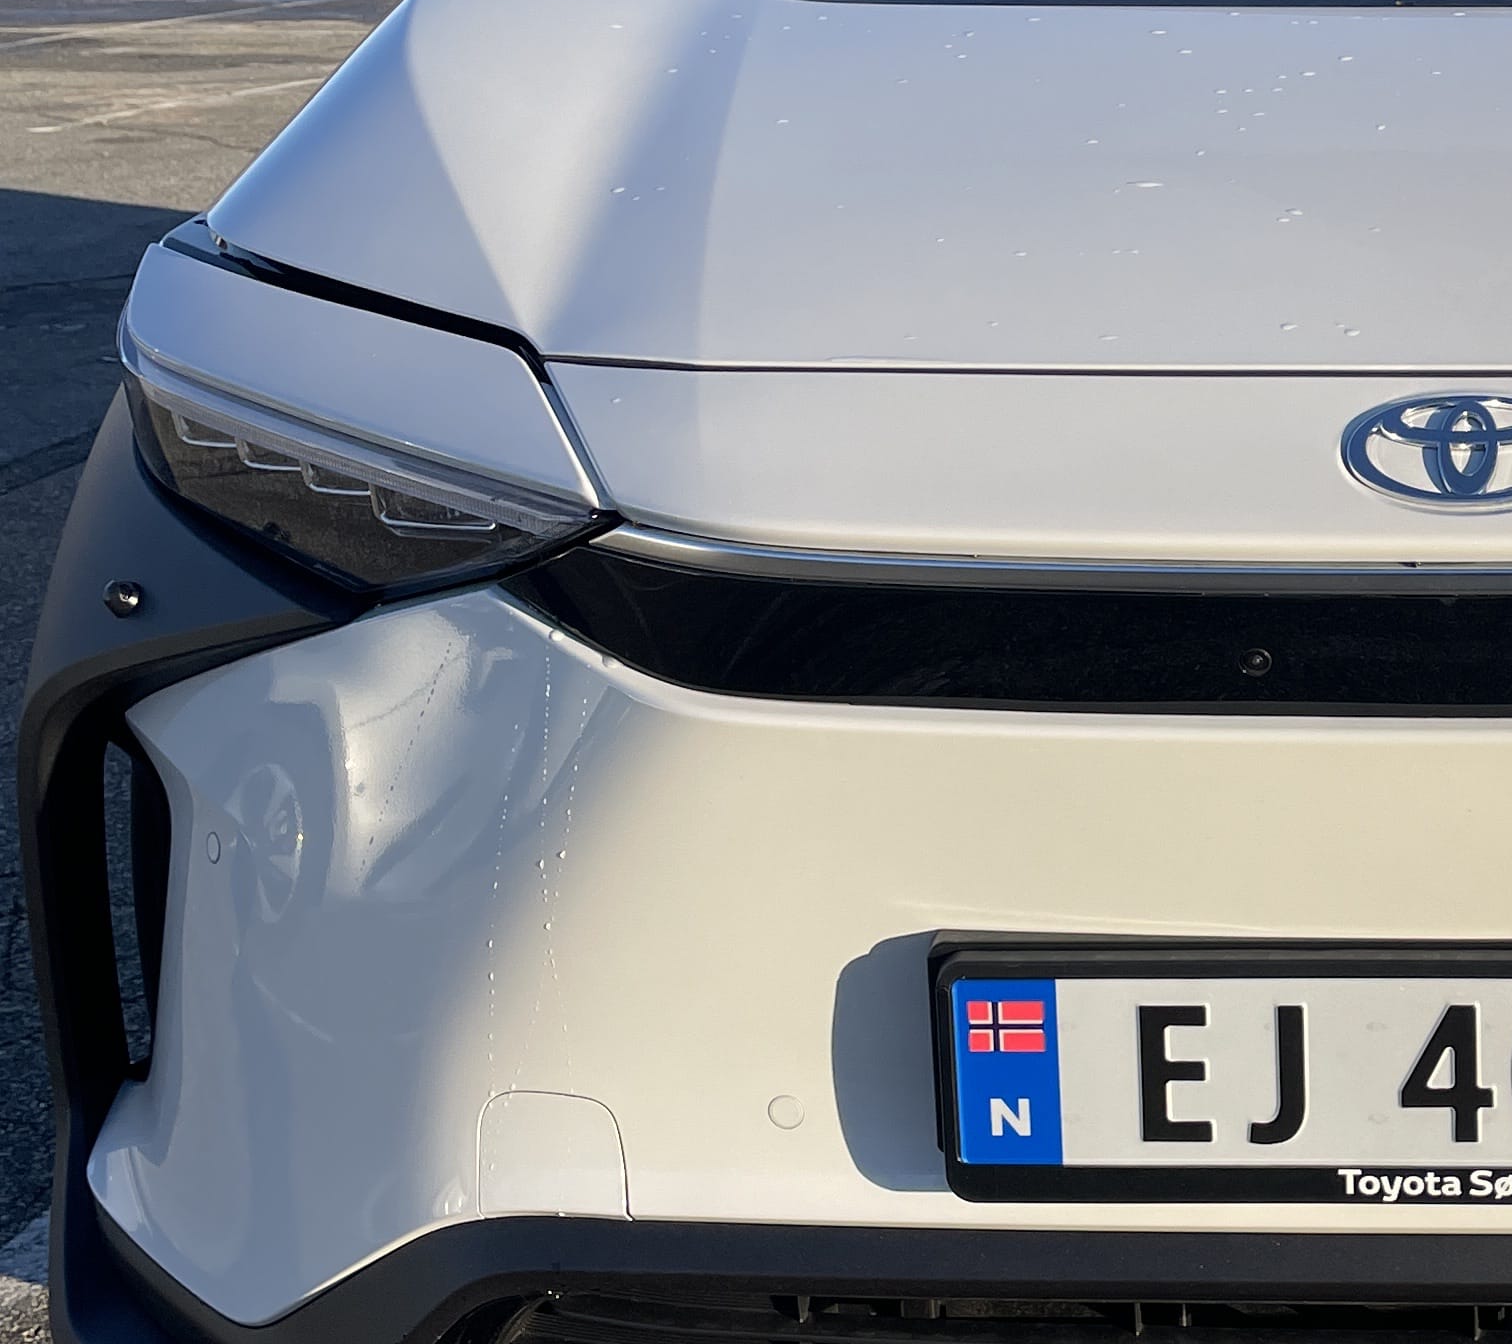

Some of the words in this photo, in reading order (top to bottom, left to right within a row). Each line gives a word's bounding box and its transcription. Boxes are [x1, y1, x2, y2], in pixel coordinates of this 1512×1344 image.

[1137, 1004, 1306, 1146] EJ
[990, 1098, 1031, 1136] N
[1337, 1168, 1463, 1203] Toyota
